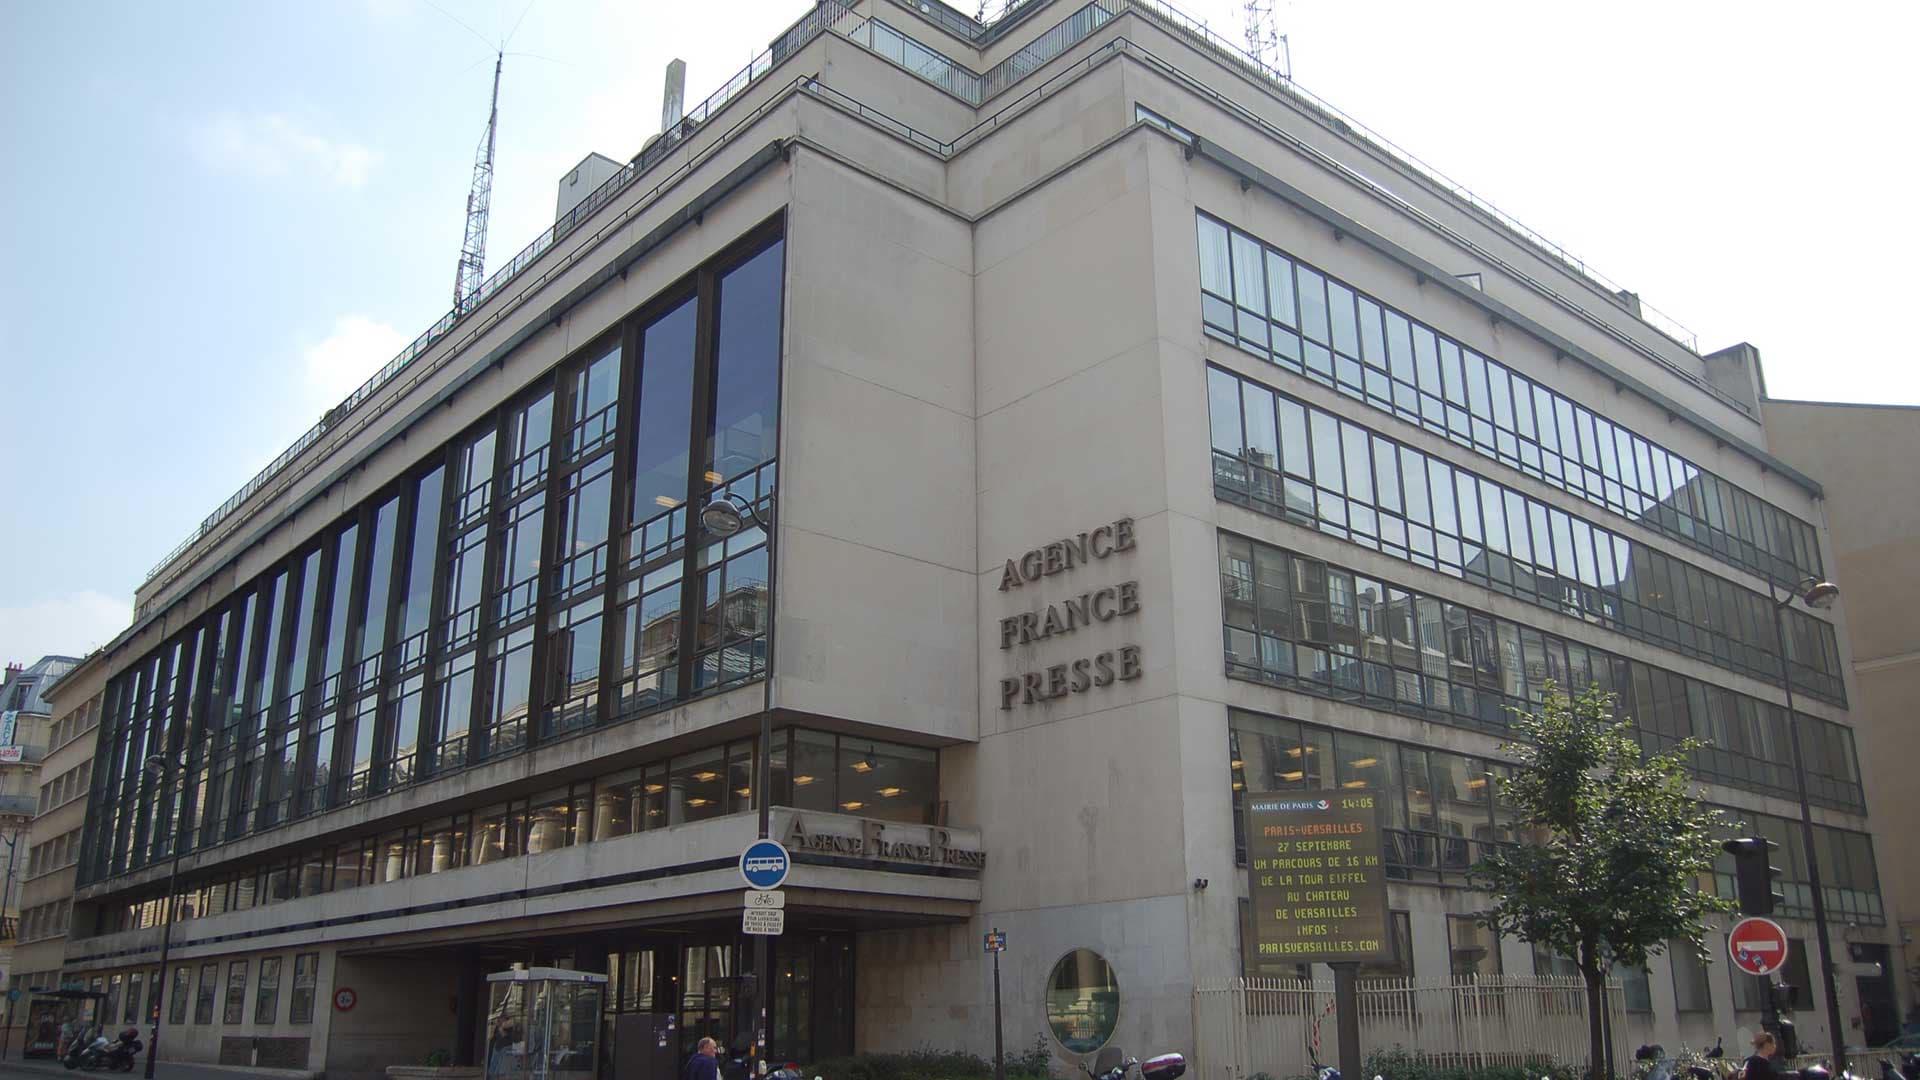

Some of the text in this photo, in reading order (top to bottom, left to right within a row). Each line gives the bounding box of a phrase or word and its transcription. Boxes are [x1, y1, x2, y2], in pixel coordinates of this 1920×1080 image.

[998, 517, 1137, 591] AGENCE
[999, 580, 1140, 650] FRANCE
[999, 644, 1143, 711] PRESSE
[1251, 803, 1278, 811] MAIRIE
[1292, 801, 1314, 809] PARIS
[1342, 797, 1374, 809] 14:05
[1264, 823, 1363, 837] PARIS-VERSAILLES
[1277, 840, 1352, 853] 27 SEPTEMBRE
[1254, 855, 1378, 870] UN PARCOURS DE 16 KM
[1261, 872, 1367, 887] DE LA TOUR EIFFEL
[1287, 890, 1350, 902] AU CHATEAU
[1275, 906, 1358, 919] DE VERSAILLES
[1296, 924, 1328, 936] INFOS
[1259, 940, 1379, 953] PARISVERSAILLES.COM
